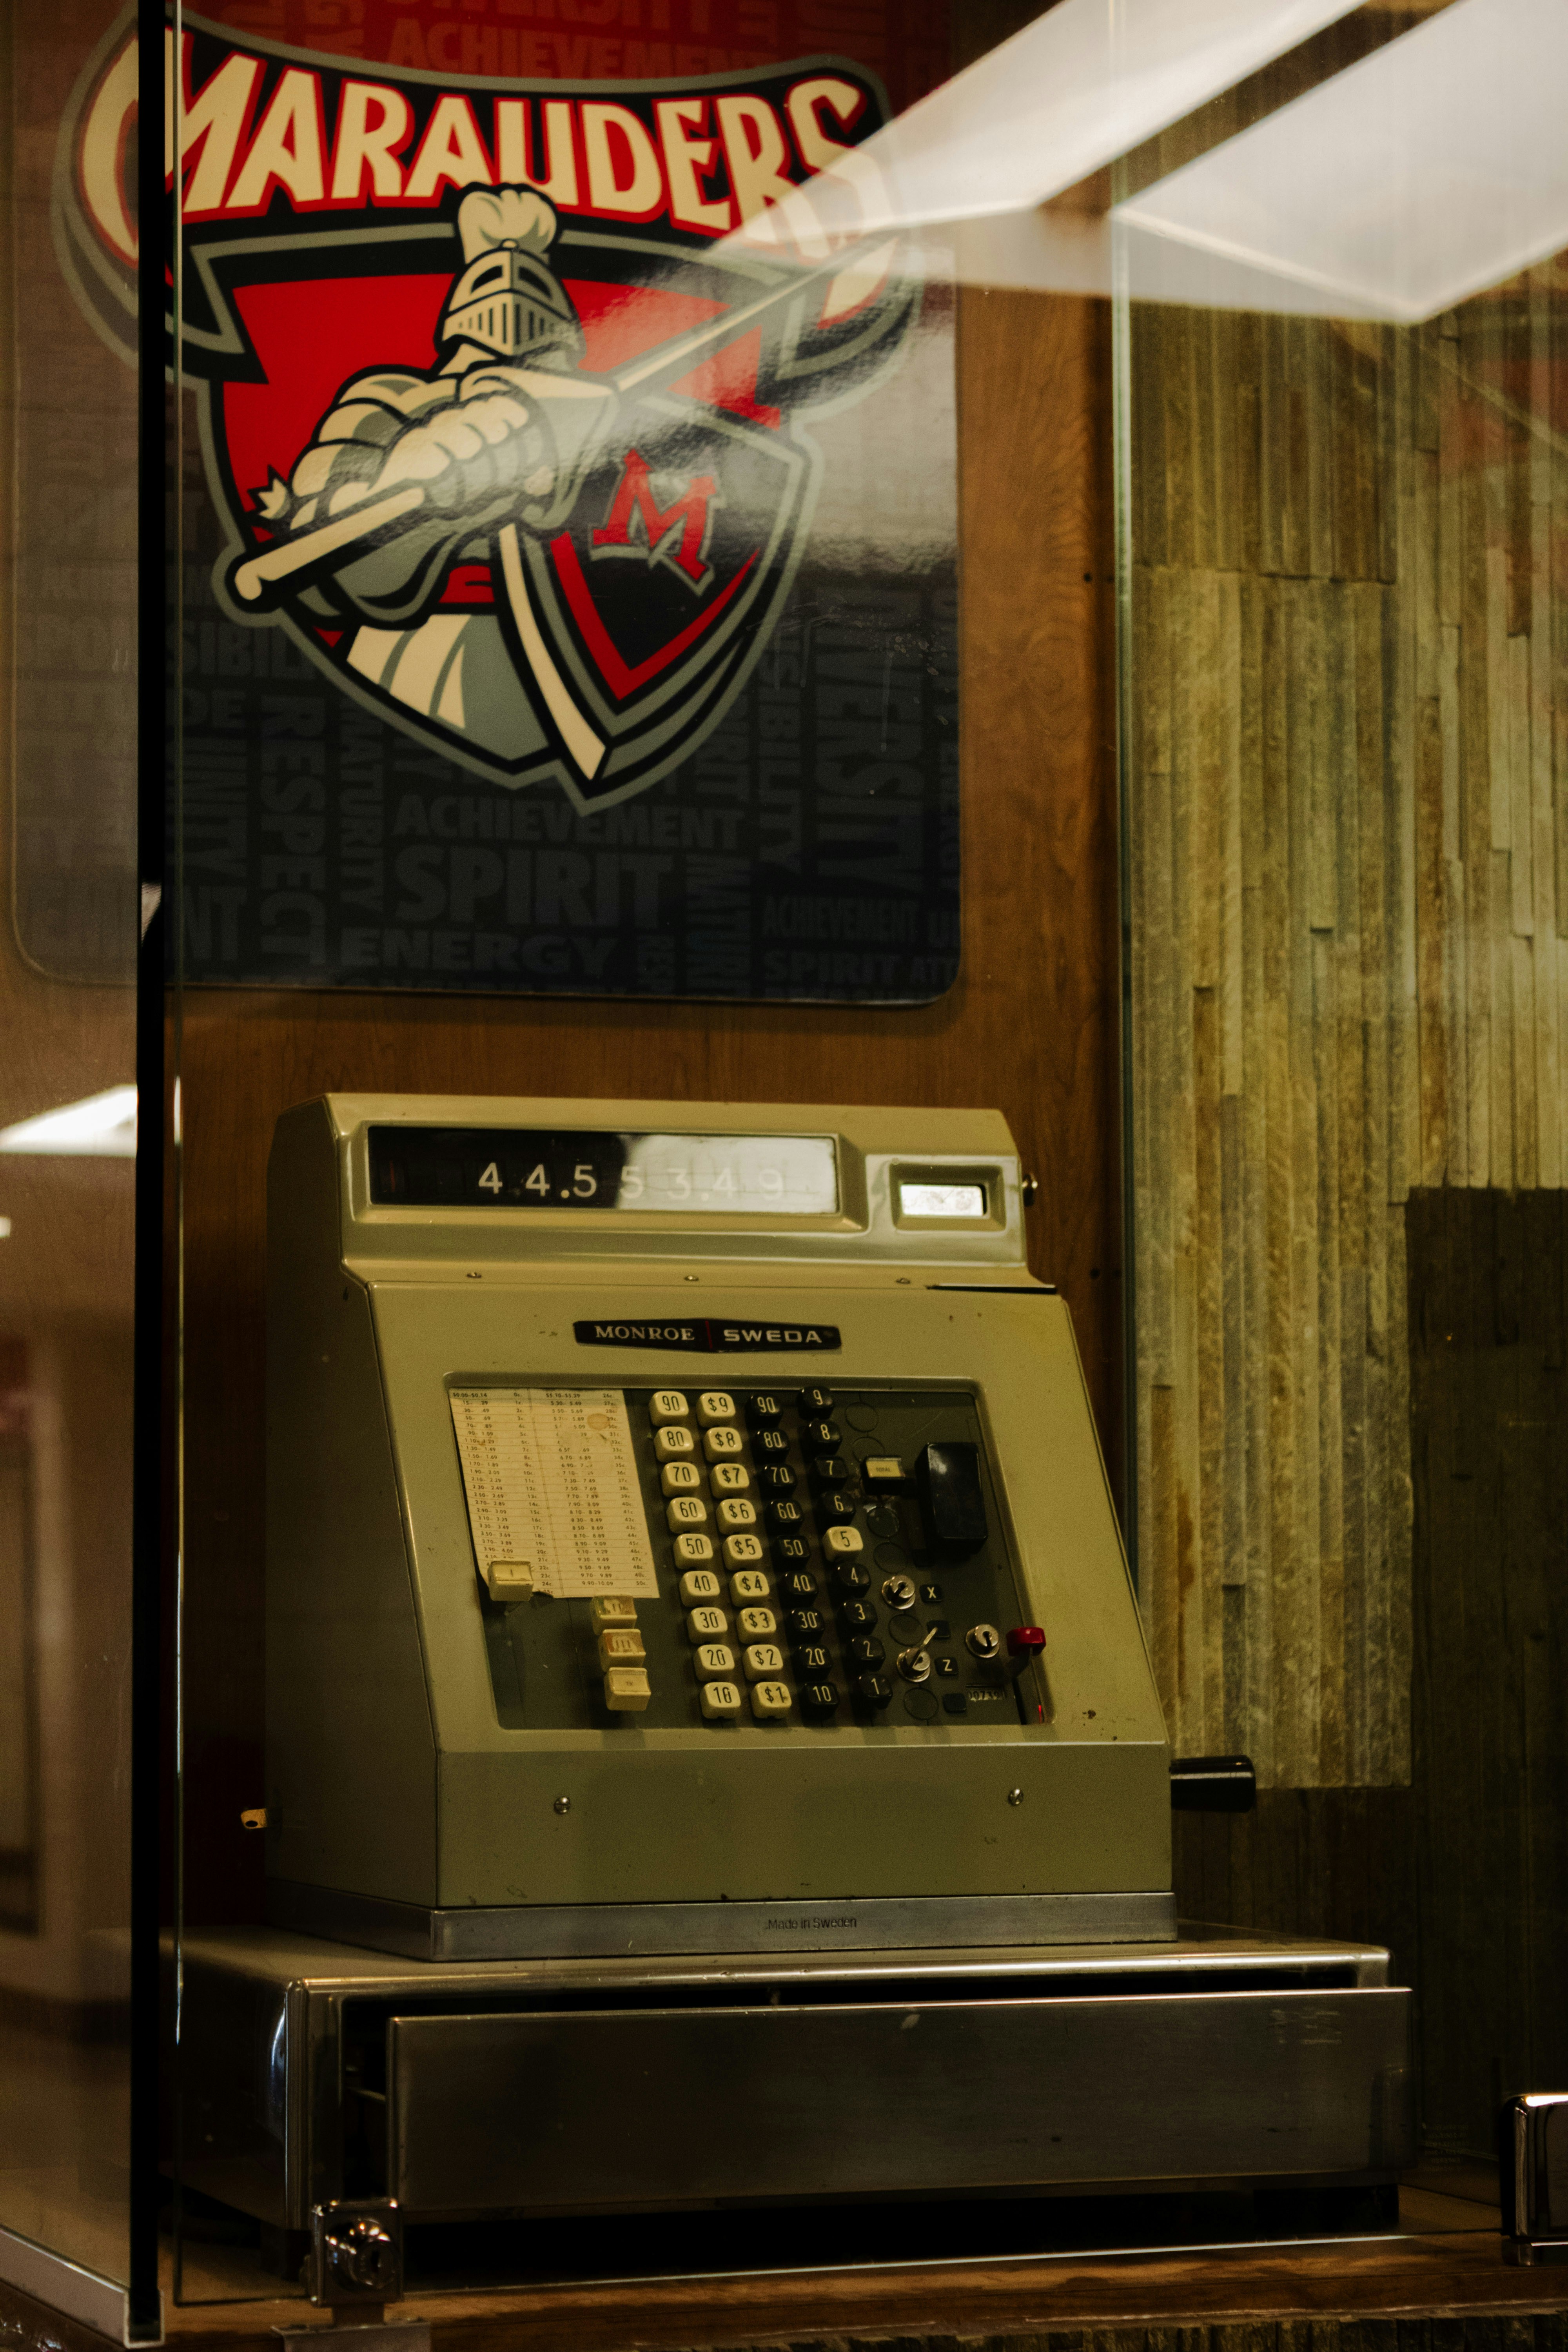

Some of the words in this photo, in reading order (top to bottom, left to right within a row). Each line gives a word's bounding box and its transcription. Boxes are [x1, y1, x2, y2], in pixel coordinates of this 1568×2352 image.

[163, 27, 886, 262] MARAUDERS
[591, 448, 718, 581] M
[815, 587, 924, 894] DIVERSITY
[339, 699, 384, 914] MATURITY
[260, 695, 326, 965] RESPECT
[393, 793, 746, 849] ACHIEVEMENT
[395, 844, 675, 930] SPIRIT
[761, 895, 918, 940] ACHIEVEMENT
[342, 927, 619, 977] ENERGY
[762, 951, 900, 985] SPIRIT
[594, 1325, 696, 1341] MONROE
[724, 1328, 823, 1344] SWEDA
[663, 1395, 681, 1412] 90
[708, 1397, 729, 1412] $9
[757, 1397, 775, 1413] 90
[814, 1391, 823, 1406] 9
[668, 1431, 685, 1447] 80
[715, 1432, 735, 1448] $8
[765, 1433, 782, 1448] 80
[821, 1425, 831, 1440] 8
[673, 1467, 691, 1483] 70
[722, 1468, 740, 1485] $7
[771, 1467, 789, 1483] 70
[826, 1460, 833, 1476] 7
[680, 1501, 698, 1518] 60
[729, 1504, 750, 1520] $6
[777, 1503, 796, 1519] 60
[835, 1495, 844, 1511] 6
[687, 1538, 704, 1555] 50
[735, 1539, 755, 1555] $5
[784, 1539, 803, 1556] 50
[841, 1531, 849, 1547] 5
[694, 1575, 711, 1592] 40
[742, 1576, 762, 1592] $4
[792, 1575, 810, 1592] 40
[851, 1567, 858, 1584] 4
[927, 1587, 936, 1598] X
[702, 1612, 719, 1628] 30
[748, 1612, 770, 1629] $3
[800, 1613, 816, 1629] 30
[857, 1604, 865, 1620] 3
[708, 1649, 726, 1666] 20
[755, 1649, 777, 1665] $2
[806, 1648, 822, 1666] 20
[864, 1641, 873, 1657] 2
[943, 1660, 952, 1671] Z
[713, 1686, 732, 1704] 10
[765, 1686, 785, 1703] $1
[813, 1686, 831, 1702] 10
[871, 1678, 880, 1695] 1
[768, 1918, 797, 1929] Made
[801, 1917, 810, 1929] in
[813, 1916, 857, 1929] Sweden
